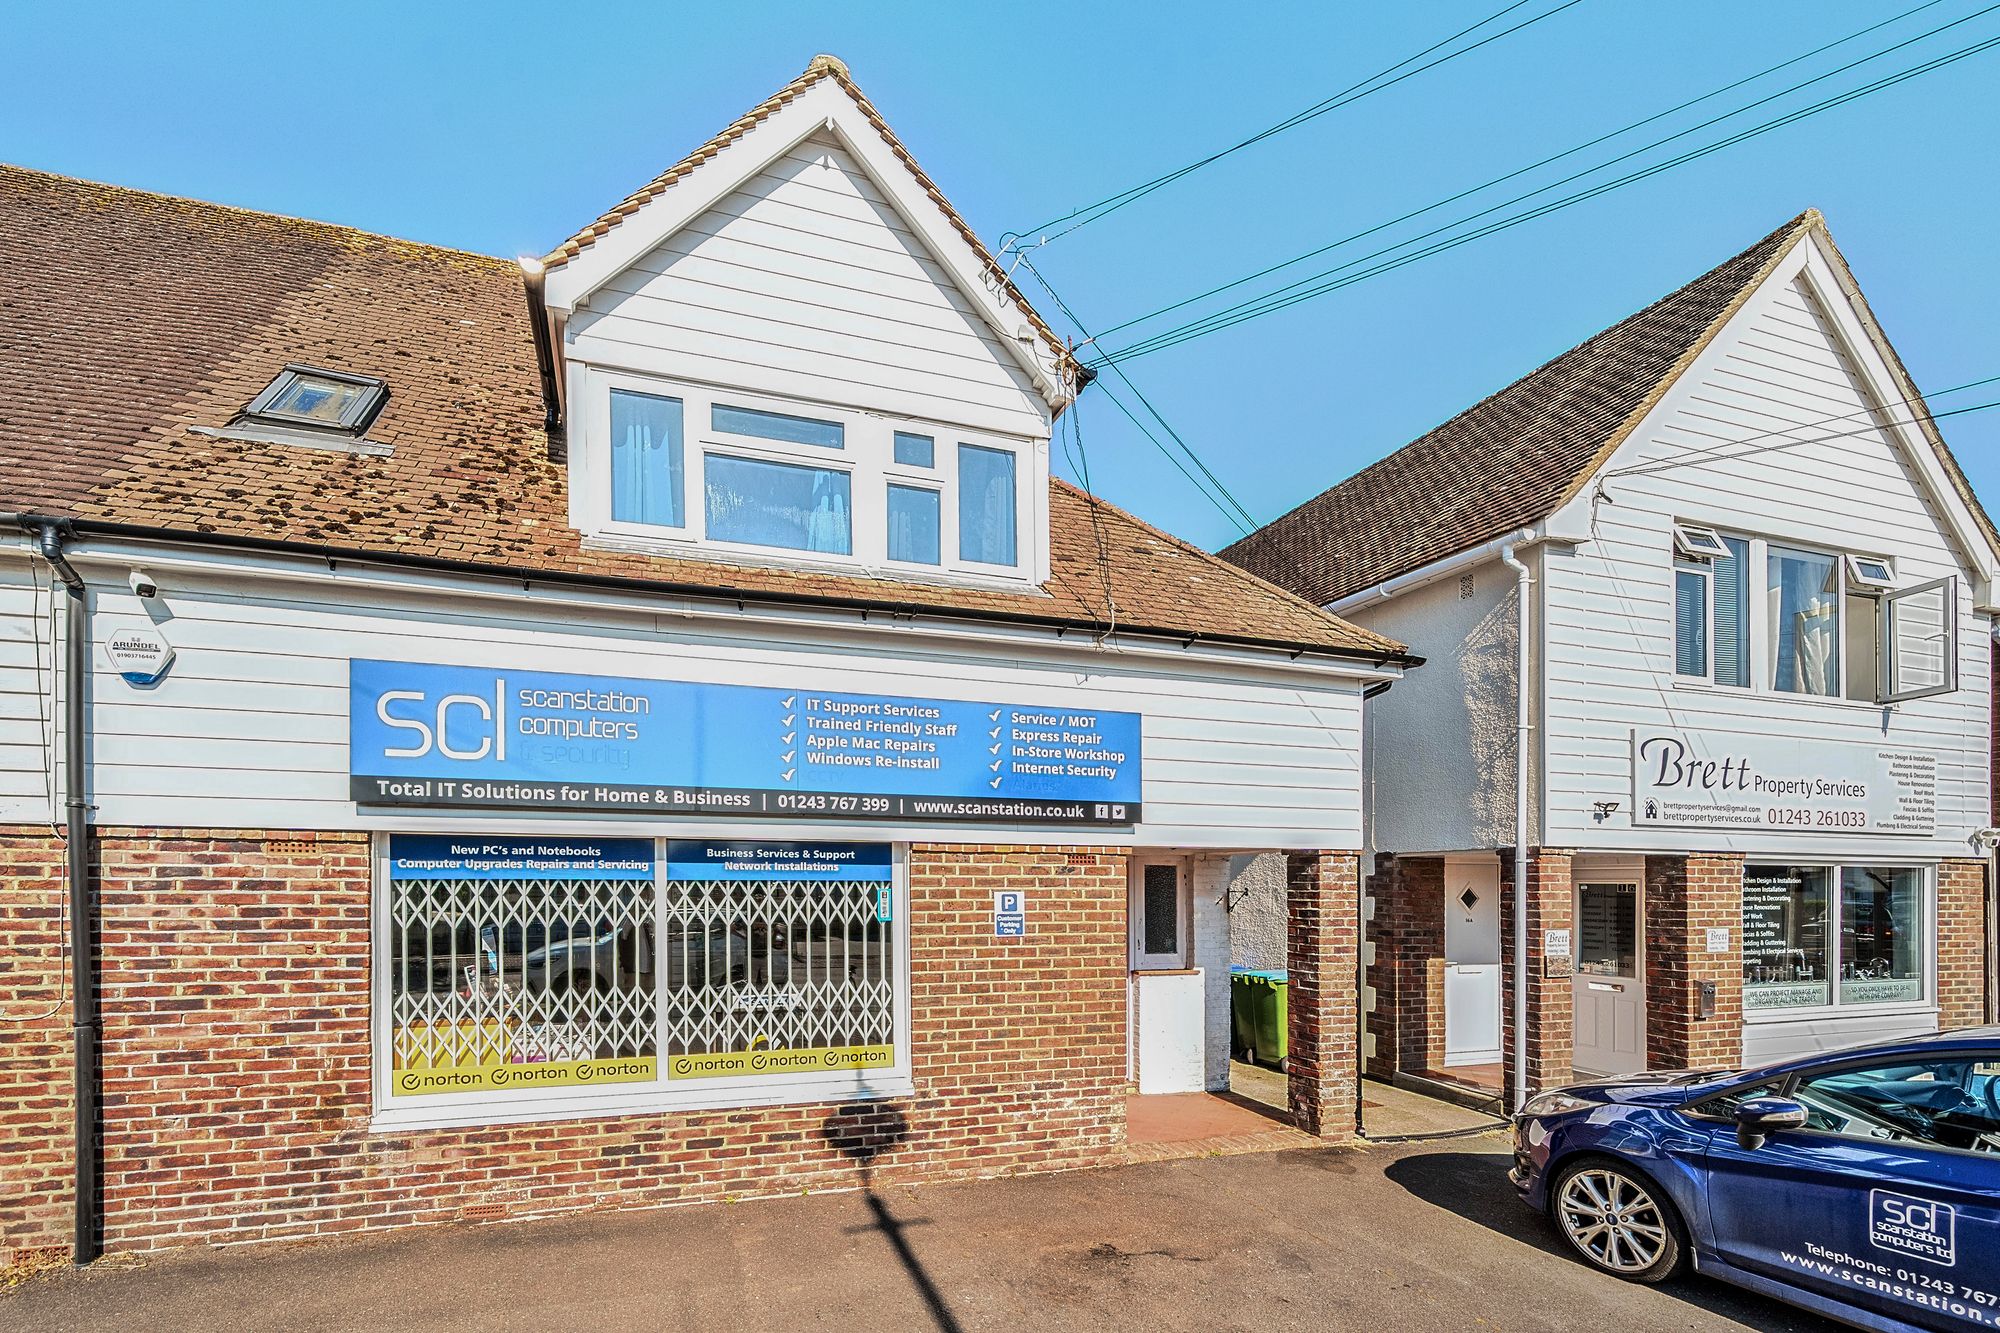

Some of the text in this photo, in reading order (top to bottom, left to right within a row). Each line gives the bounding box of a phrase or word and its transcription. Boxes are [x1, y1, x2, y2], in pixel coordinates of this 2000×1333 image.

[112, 641, 161, 649] ARUNDEL
[519, 689, 650, 714] scanstation
[806, 698, 940, 718] IT Support Services
[519, 717, 639, 740] computers
[806, 716, 958, 737] Trained Friendly Staff
[1011, 712, 1057, 726] Service
[1068, 716, 1096, 728] MOT
[806, 734, 936, 753] Apple Mac Repairs
[1012, 729, 1102, 746] Express Repair
[806, 752, 940, 769] Windows Re-install
[1012, 745, 1126, 764] In-Store Workshop
[1894, 754, 1908, 762] Design
[1012, 762, 1117, 780] Internet Security
[1640, 737, 1866, 798] Brett Property Services
[1889, 771, 1909, 779] Plastering
[376, 780, 1085, 818] Total IT Solutions for Home & Business 01243 767 399 www.scanstation.co.uk
[1663, 801, 1761, 813] brettpropertyservices@gmail.com
[1663, 812, 1761, 824] brettpropertyservices.co.uk
[1768, 808, 1866, 827] 01243 261033
[1876, 822, 1896, 830] Plumbing
[1893, 814, 1911, 822] Cladding
[451, 845, 602, 857] New PC's and Notebooks
[706, 849, 856, 861] Business Services & Support
[396, 858, 650, 872] Computer Upgrades Repairs and Servicing
[724, 862, 839, 873] Network Installations
[1004, 896, 1015, 910] P
[1546, 931, 1568, 943] Brett
[1707, 930, 1727, 940] Brett
[694, 1050, 887, 1070] norton norton norton
[424, 1062, 649, 1086] norton norton norton
[1876, 1221, 1947, 1246] scanstation
[1871, 1231, 1953, 1259] computers ltd
[1804, 1242, 1892, 1276] Telephone:
[1897, 1269, 1955, 1295] 01243
